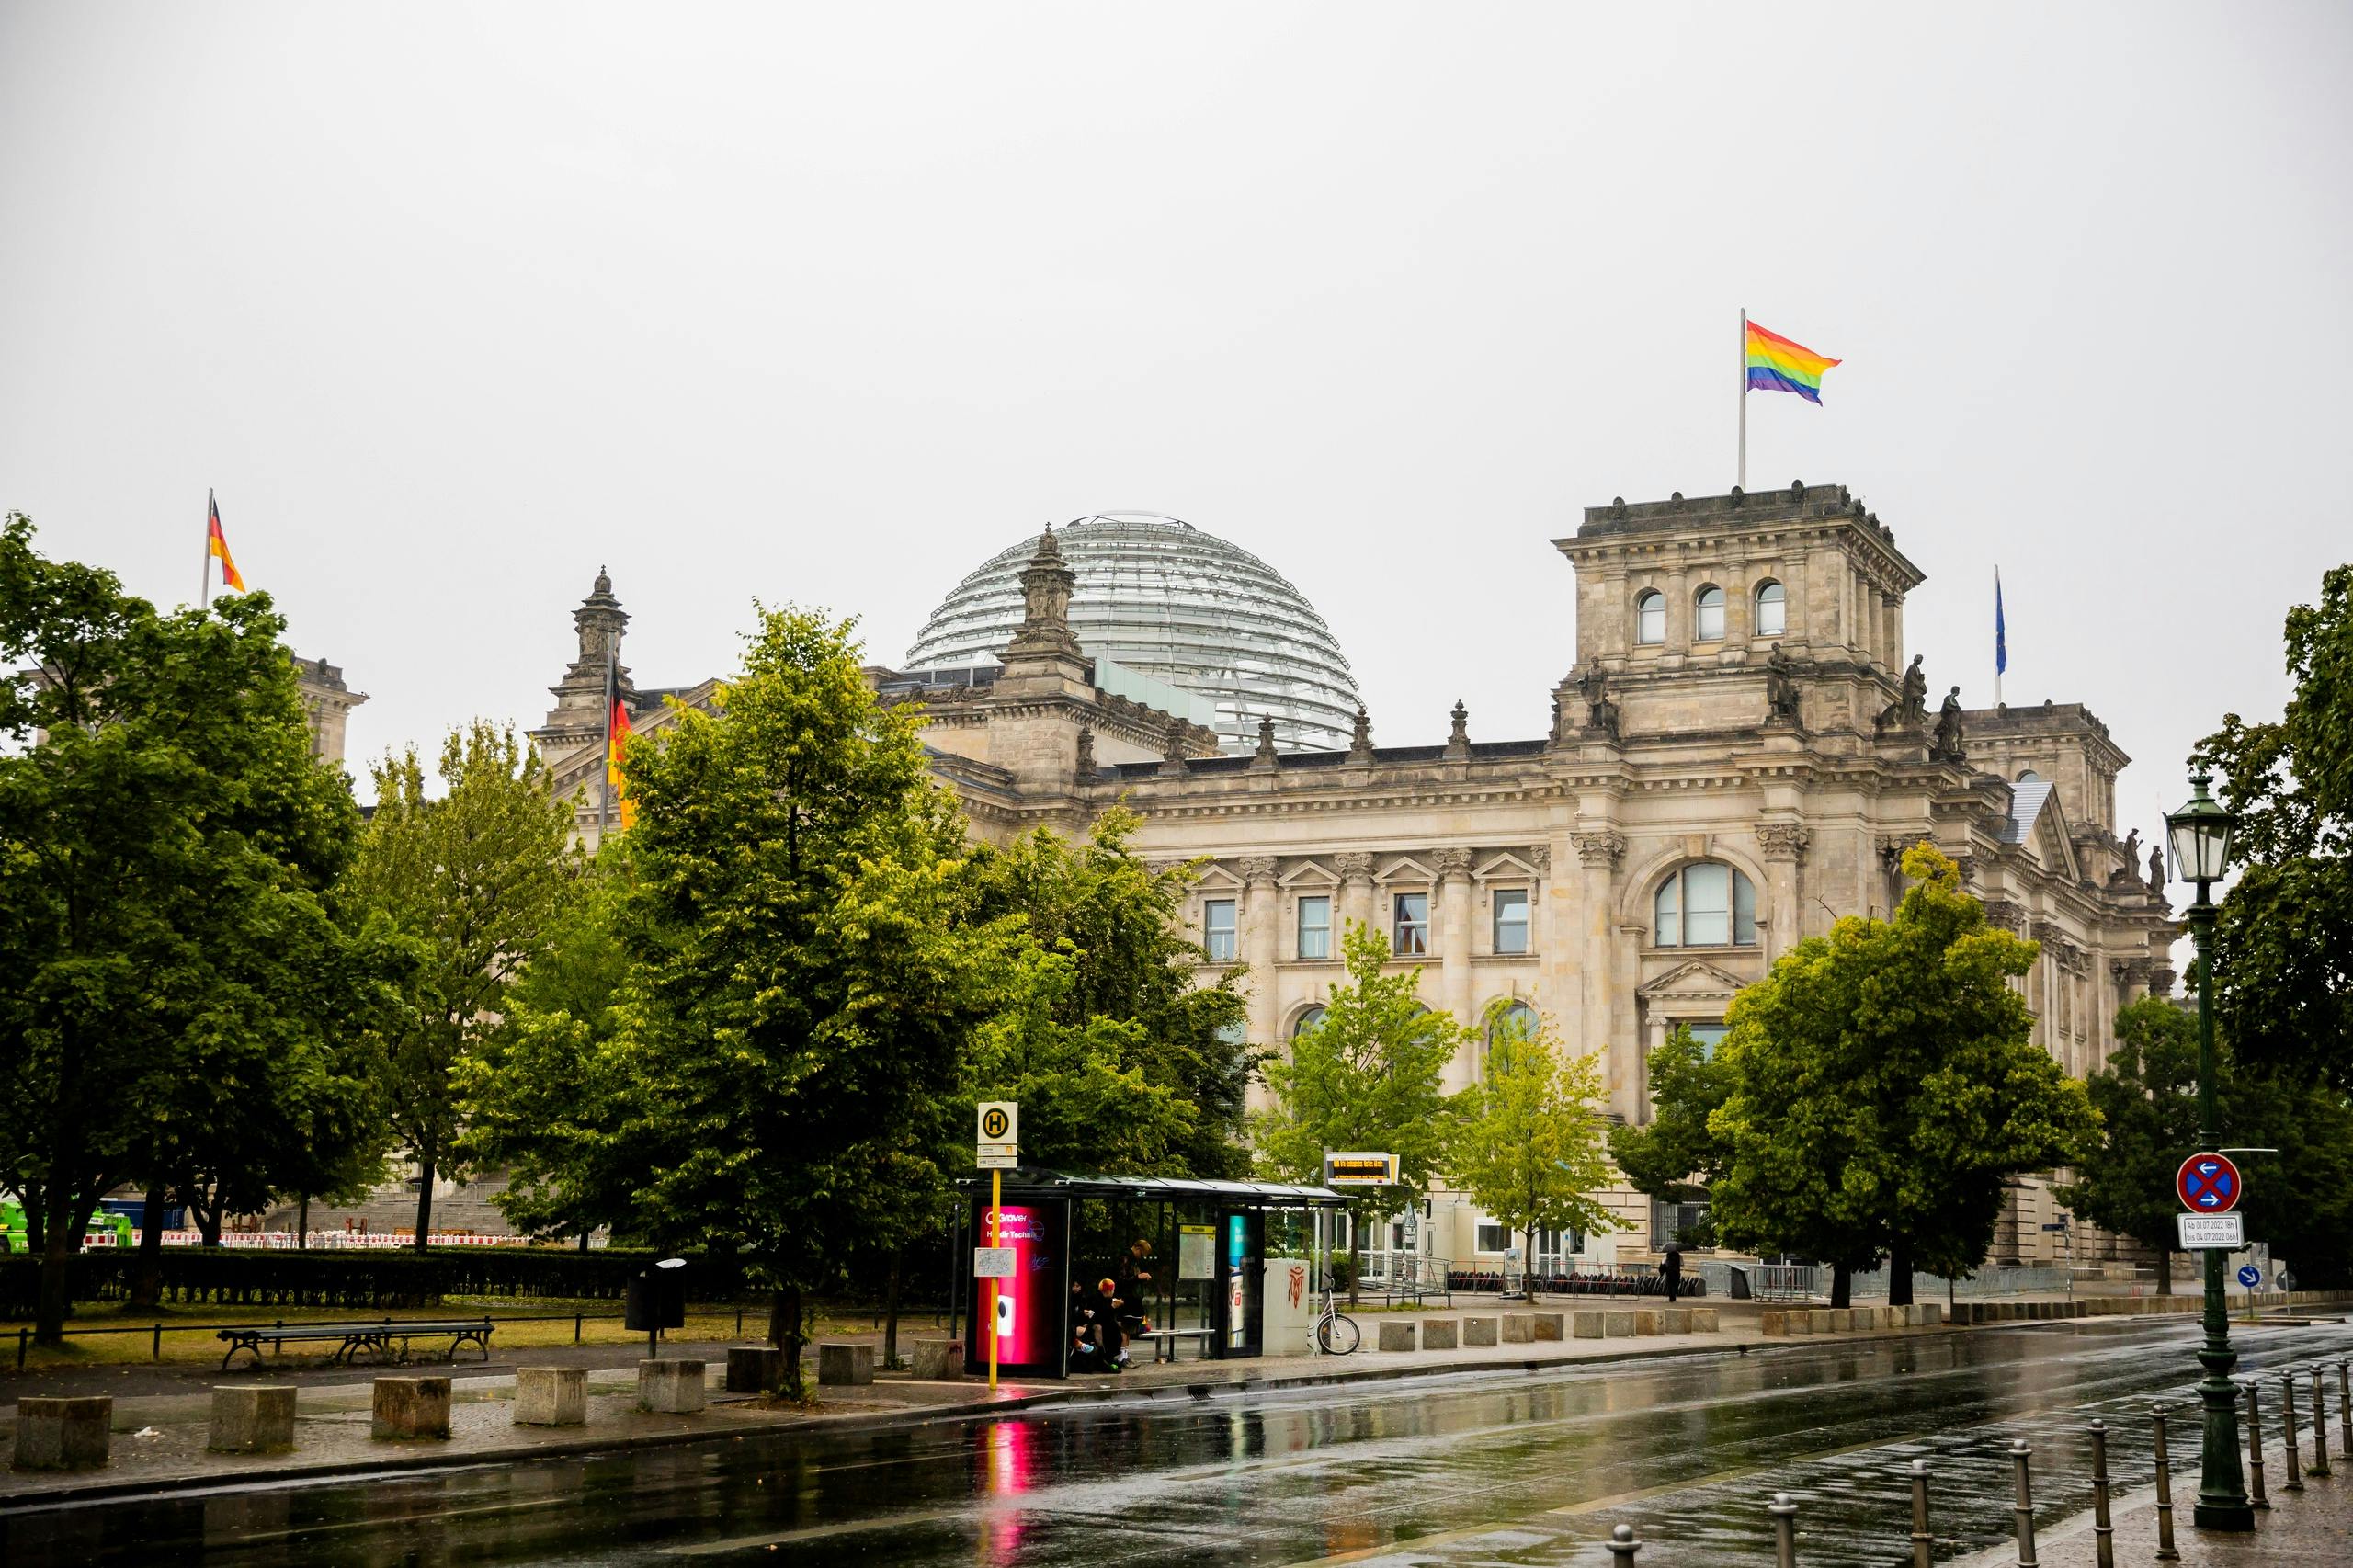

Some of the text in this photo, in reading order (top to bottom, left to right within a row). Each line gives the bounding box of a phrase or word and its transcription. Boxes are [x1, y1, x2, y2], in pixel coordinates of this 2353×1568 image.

[988, 1115, 1002, 1132] H
[999, 1213, 1027, 1222] Grover
[2188, 1221, 2196, 1230] Ab
[2187, 1233, 2195, 1242] bis
